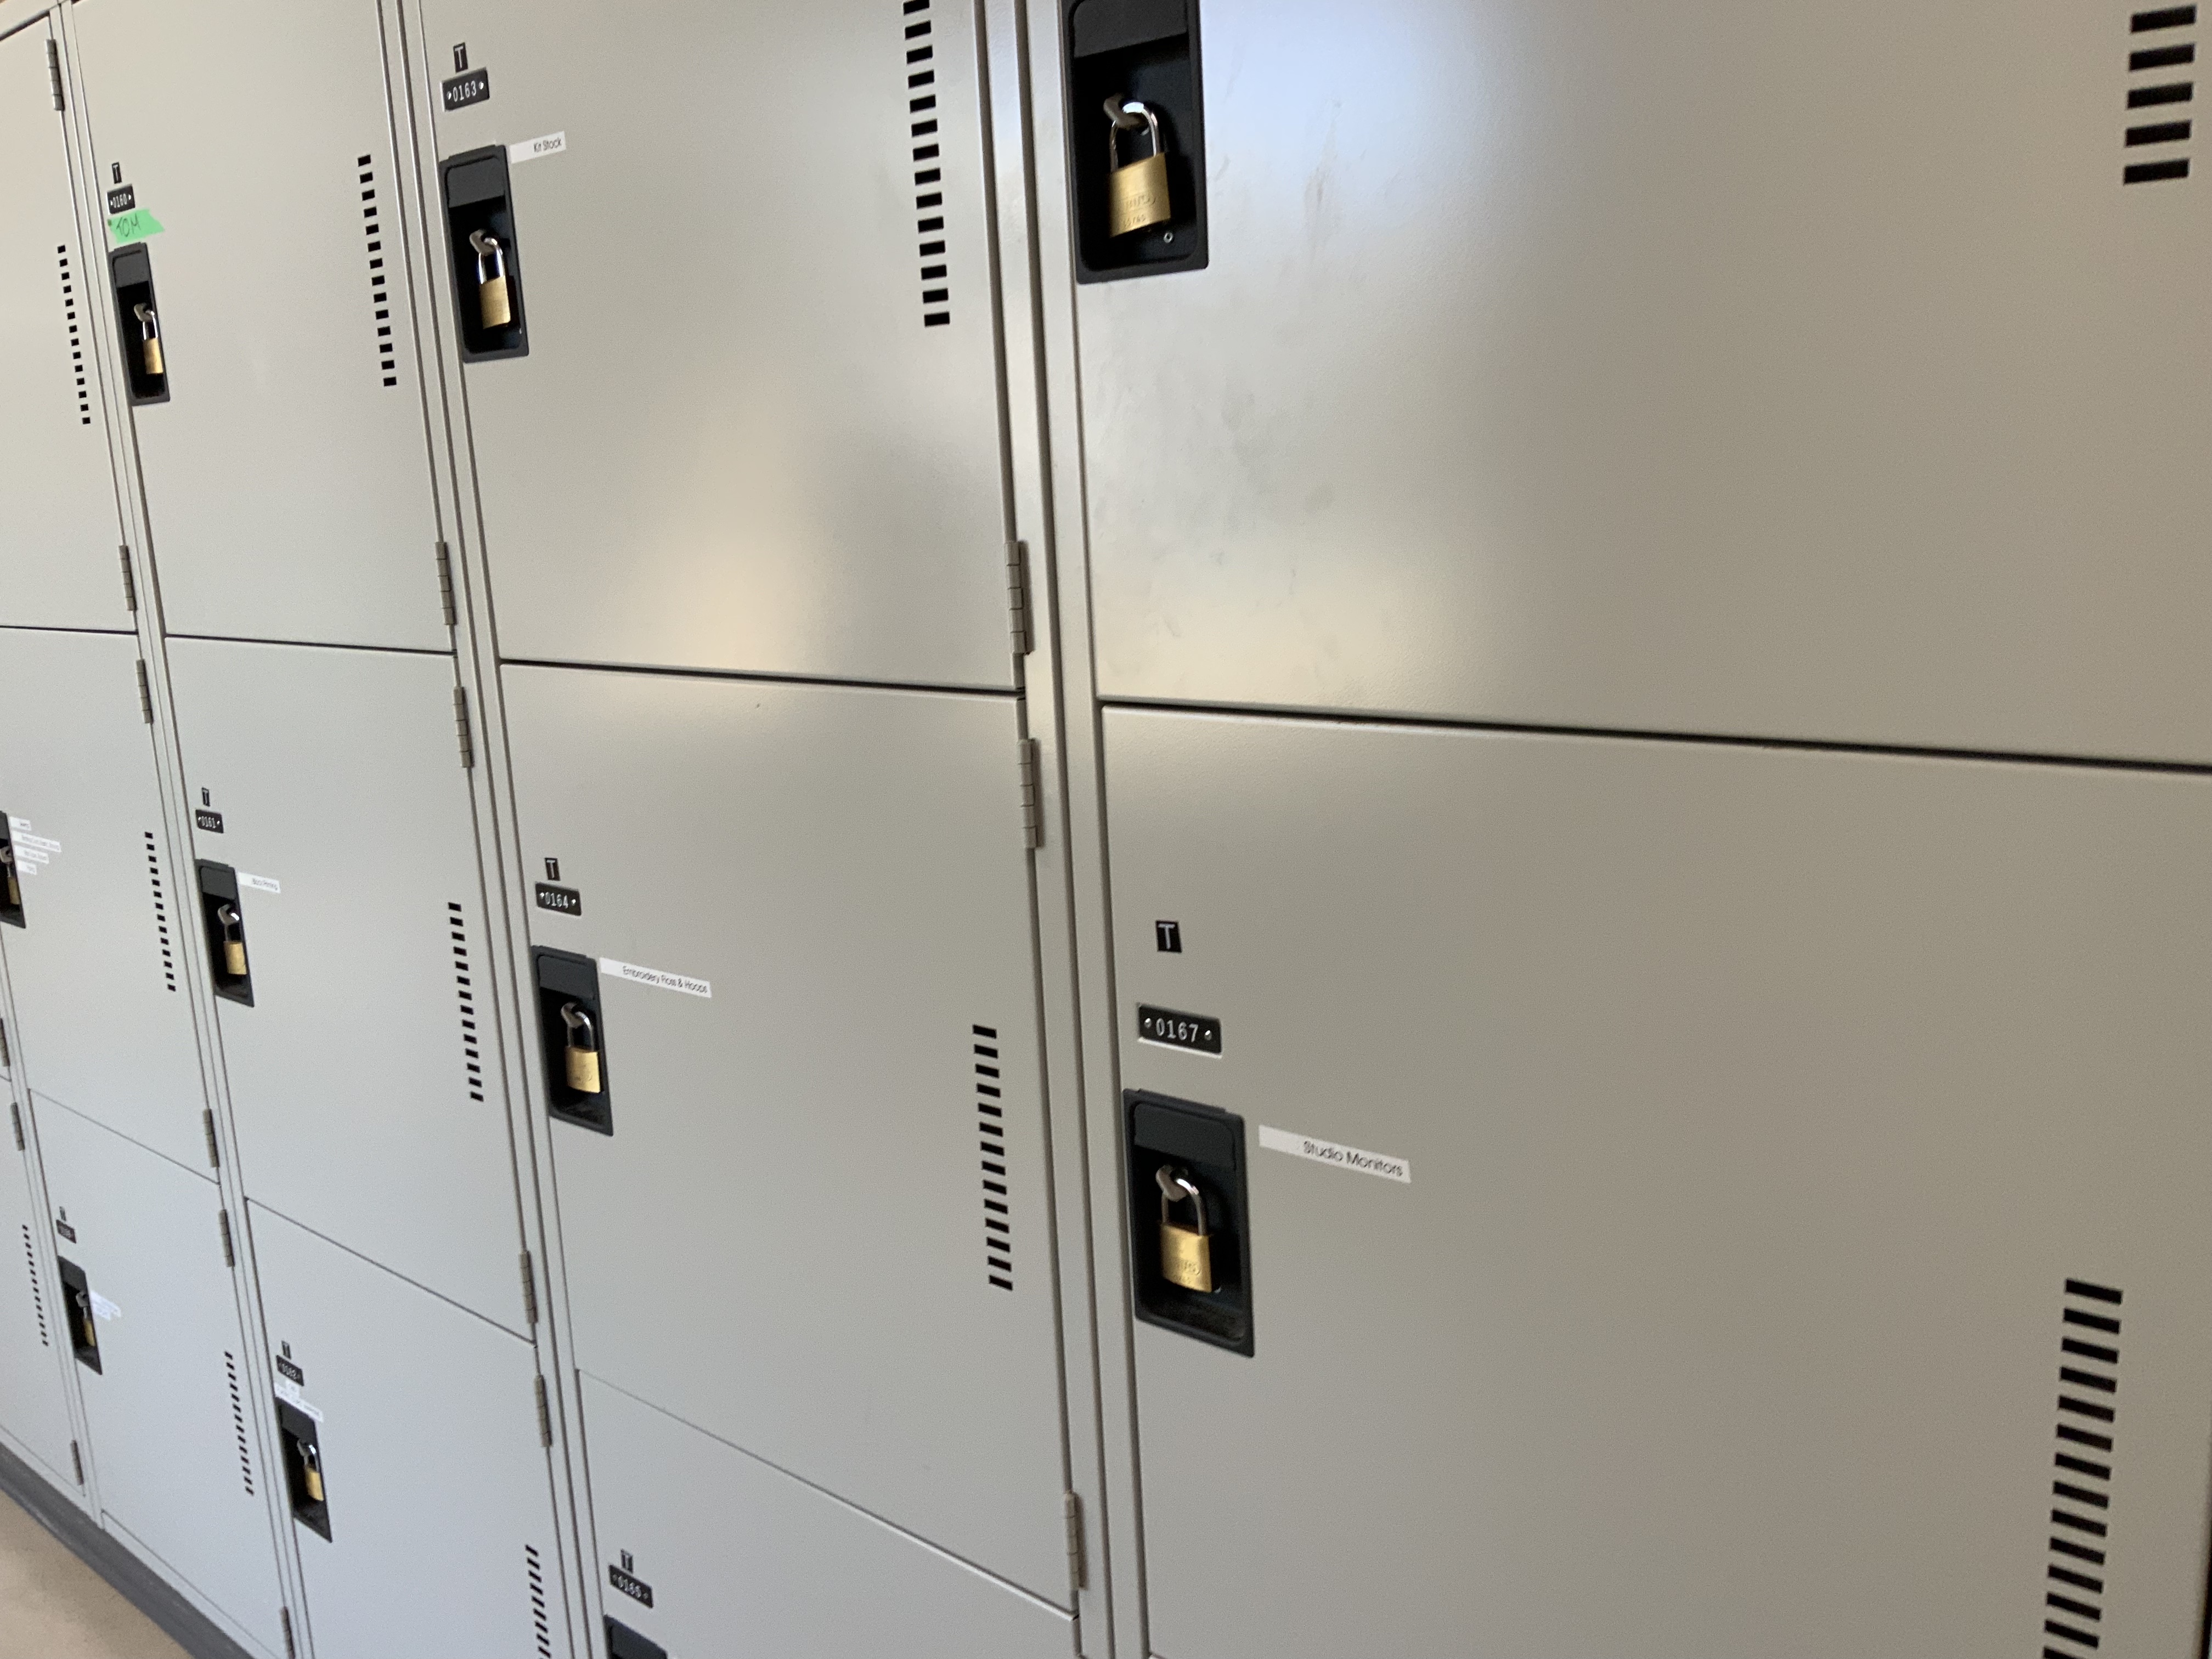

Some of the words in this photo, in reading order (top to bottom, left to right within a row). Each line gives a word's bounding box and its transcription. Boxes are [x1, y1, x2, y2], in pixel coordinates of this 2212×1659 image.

[454, 46, 464, 69] T
[453, 80, 477, 102] 0163
[533, 143, 541, 153] Kit
[543, 137, 562, 151] Stock
[112, 164, 119, 182] T
[112, 193, 127, 208] 0160
[116, 212, 142, 237] TOM
[546, 859, 555, 878] T
[545, 891, 568, 909] 0164
[1158, 923, 1176, 950] T
[1155, 1018, 1199, 1043] 0167
[1304, 1140, 1344, 1163] Studio
[1346, 1150, 1403, 1177] Monitors
